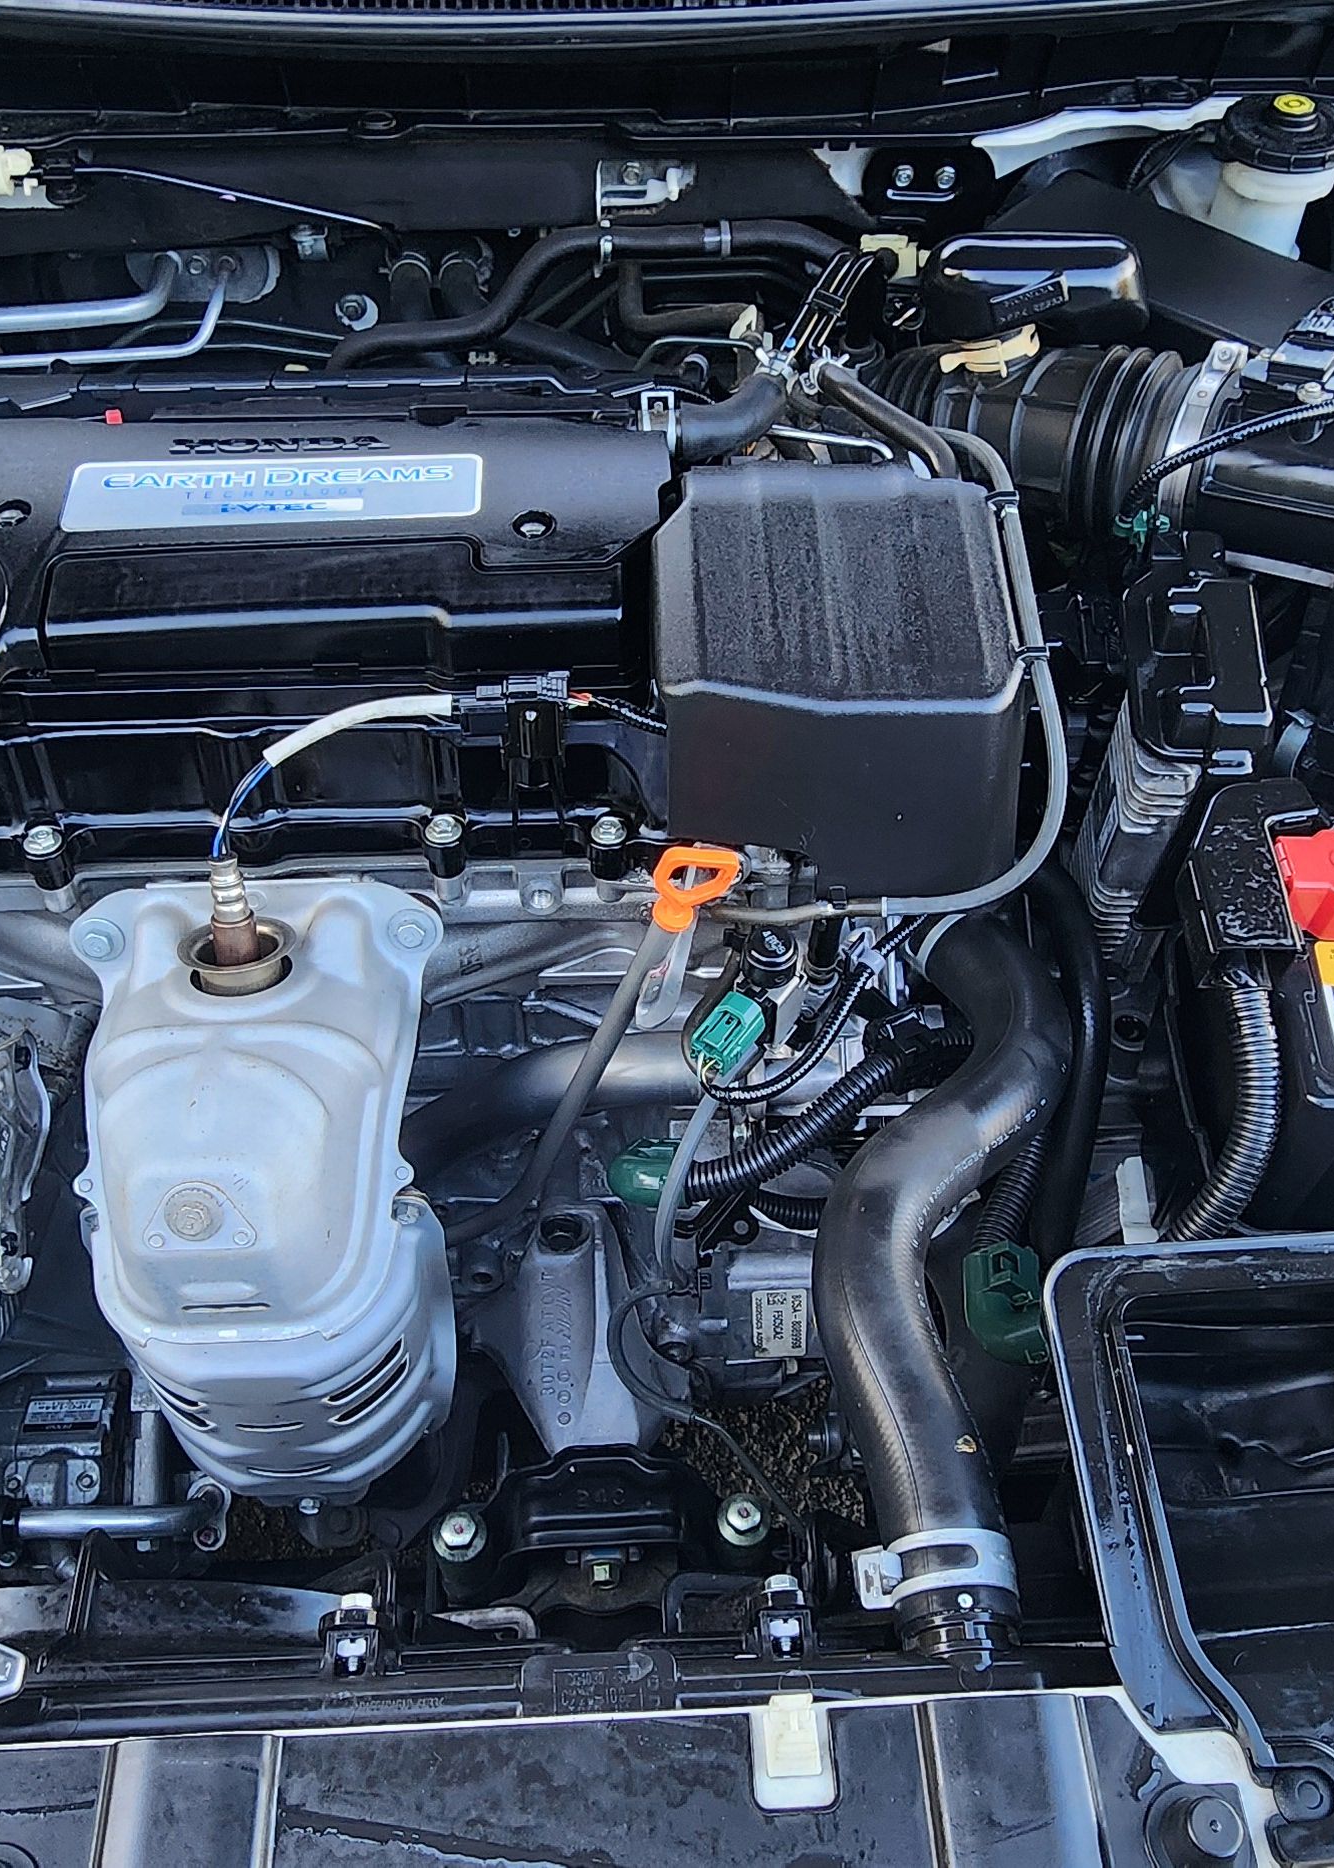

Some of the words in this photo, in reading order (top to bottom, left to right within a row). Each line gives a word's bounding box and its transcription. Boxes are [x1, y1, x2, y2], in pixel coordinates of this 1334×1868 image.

[168, 435, 391, 455] HONDA
[101, 470, 259, 490] EARTH
[264, 464, 454, 486] DREAMS
[184, 488, 365, 500] TECHNOLOGY
[220, 502, 329, 514] i-VTEC
[990, 1124, 1022, 1149] Y-TEC
